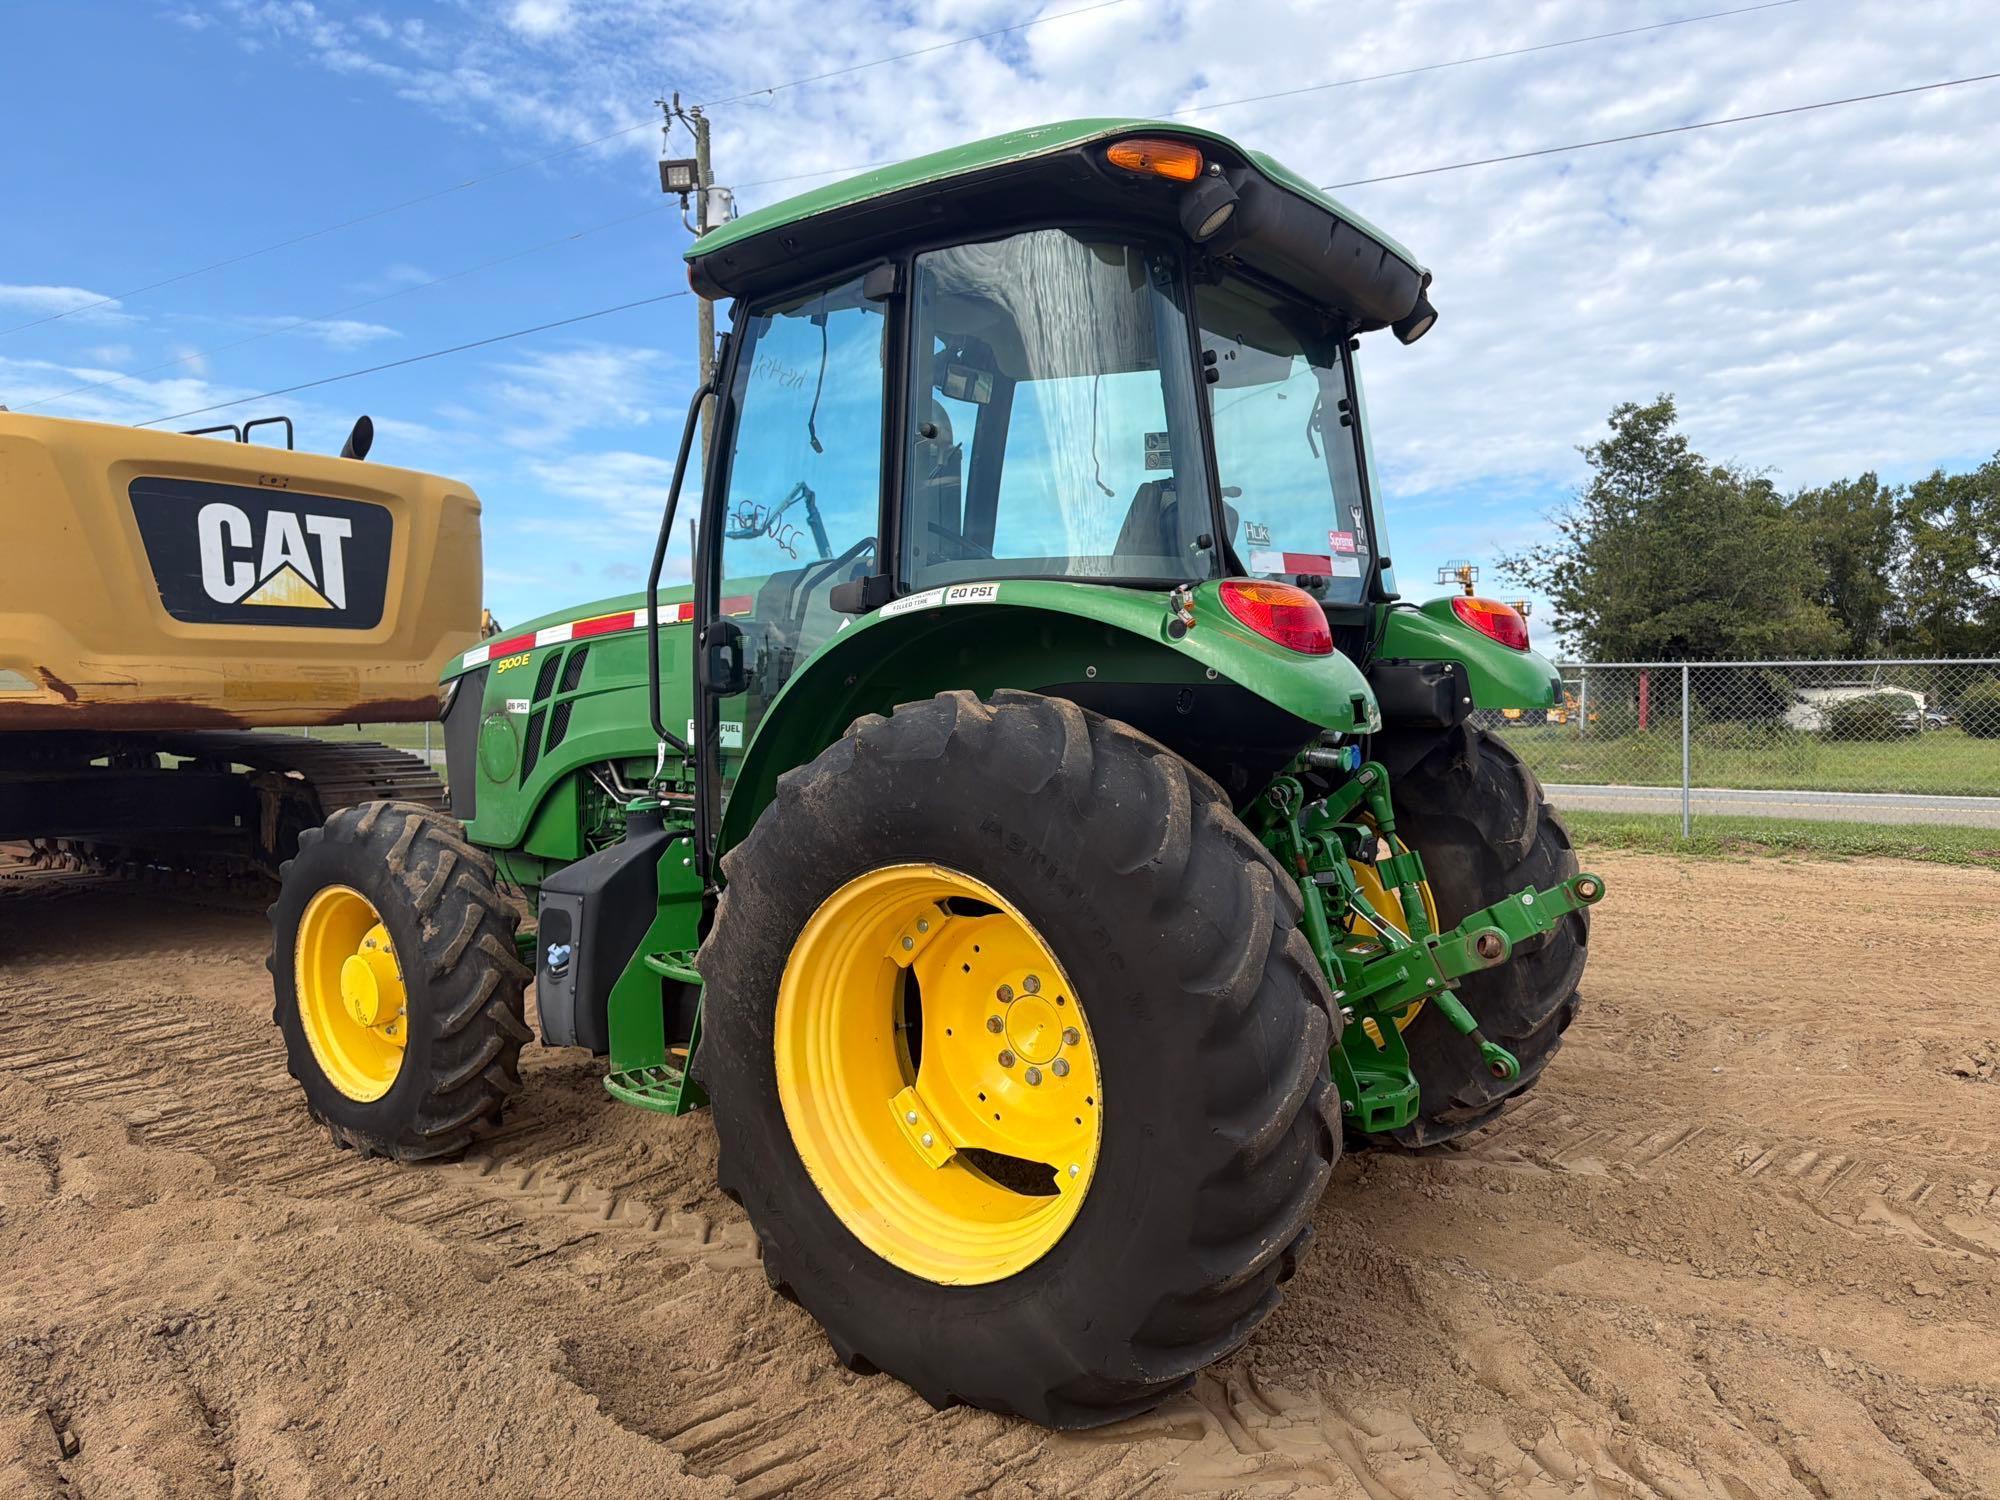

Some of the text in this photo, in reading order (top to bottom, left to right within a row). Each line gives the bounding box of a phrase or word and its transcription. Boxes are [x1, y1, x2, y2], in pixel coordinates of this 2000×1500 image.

[1245, 522, 1269, 540] Huk
[197, 502, 353, 610] CAT
[951, 588, 967, 599] 20
[970, 586, 994, 598] PSI
[892, 598, 929, 611] FILLED TIRE
[516, 702, 528, 710] PSI
[720, 724, 740, 733] FUEL
